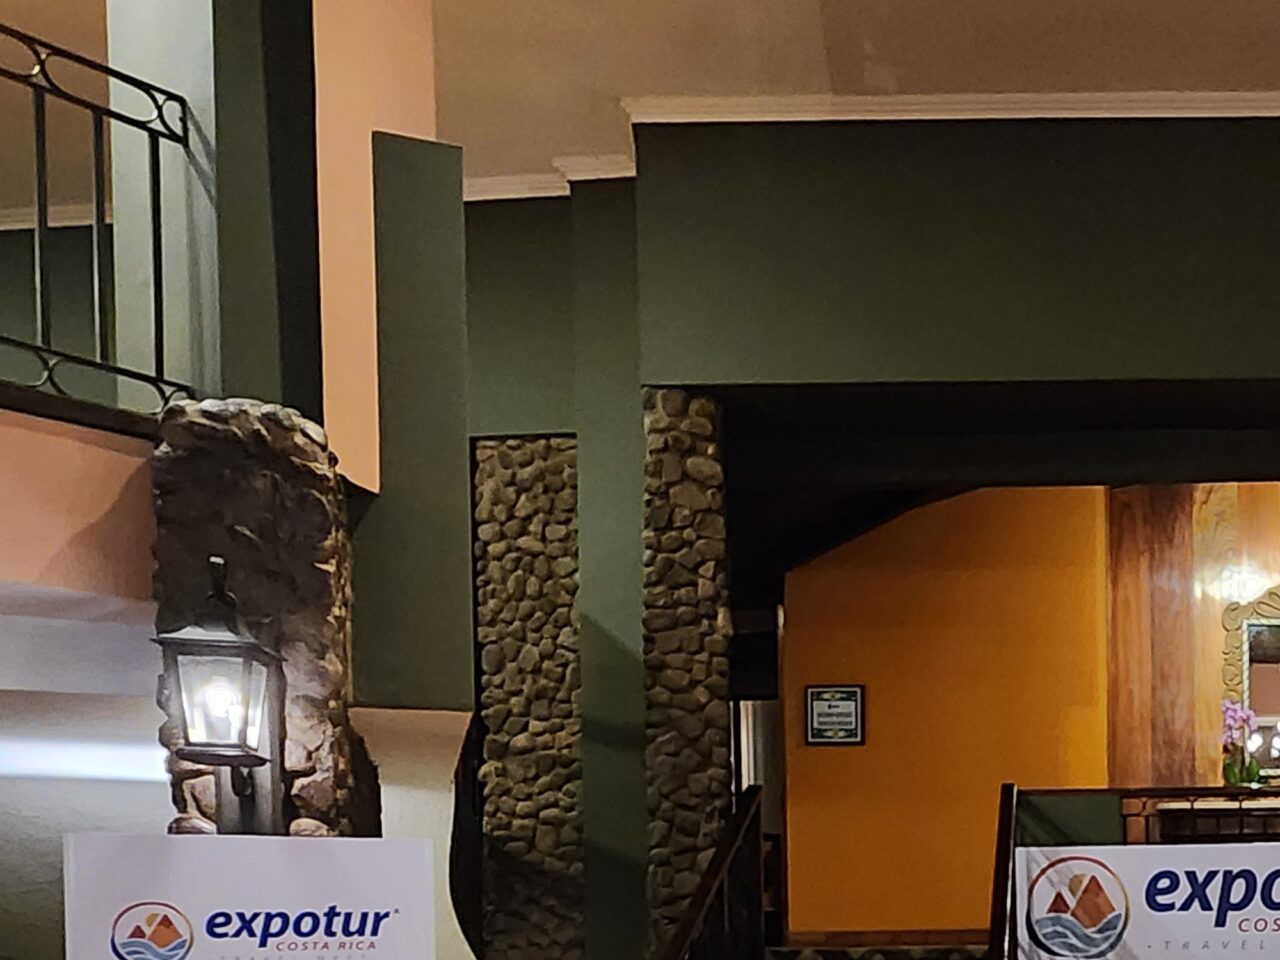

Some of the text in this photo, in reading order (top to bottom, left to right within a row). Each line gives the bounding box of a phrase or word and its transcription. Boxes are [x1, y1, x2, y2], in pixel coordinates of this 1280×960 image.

[205, 905, 391, 948] expotur
[275, 940, 377, 952] COSTA RICA
[1163, 939, 1267, 950] TRAVEL
